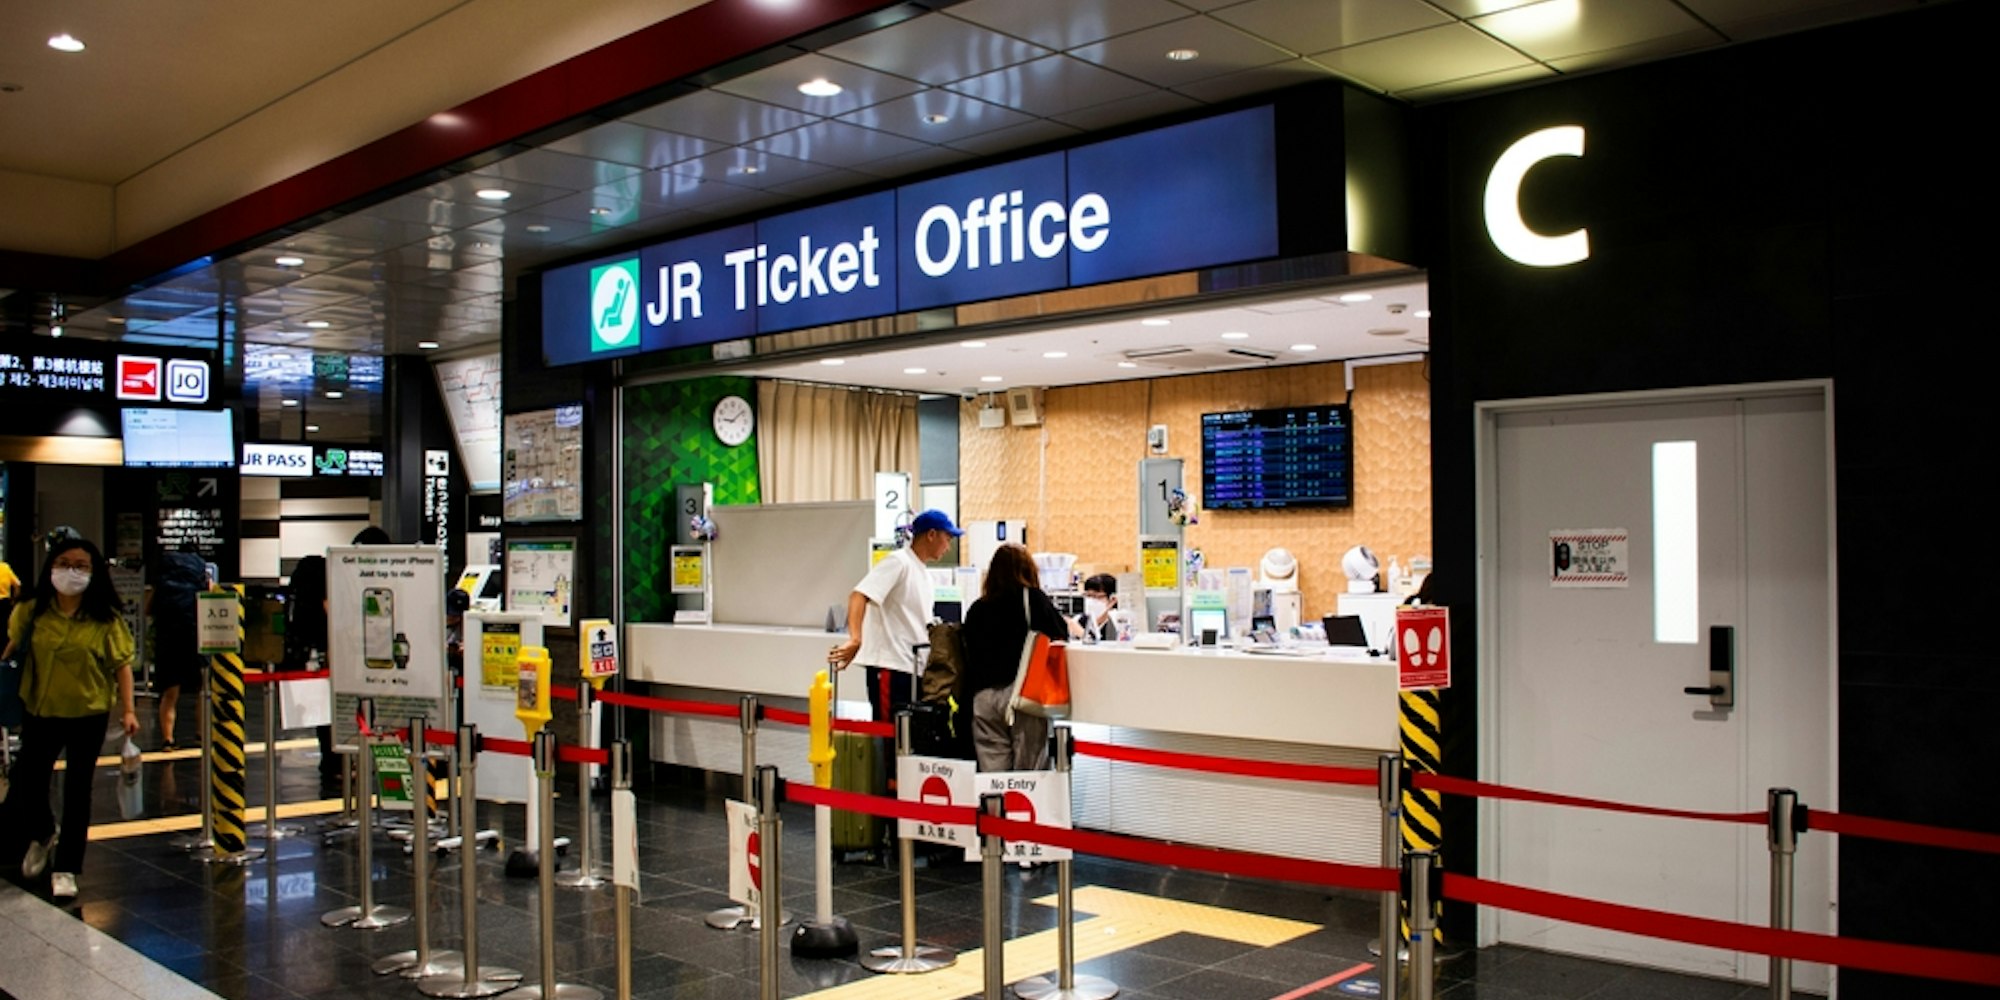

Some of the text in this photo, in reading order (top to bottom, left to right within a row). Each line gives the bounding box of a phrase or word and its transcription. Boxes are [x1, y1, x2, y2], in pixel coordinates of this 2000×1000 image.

[1484, 125, 1590, 267] C
[646, 189, 1111, 327] JR Ticket Office
[176, 373, 200, 390] JO
[244, 453, 307, 468] JR PASS
[1158, 479, 1167, 501] 1
[685, 498, 697, 515] 3
[885, 490, 899, 509] 2
[1577, 540, 1609, 550] STOP
[408, 556, 434, 564] iPhone
[919, 762, 954, 777] No Entry
[991, 778, 1036, 791] No Entry
